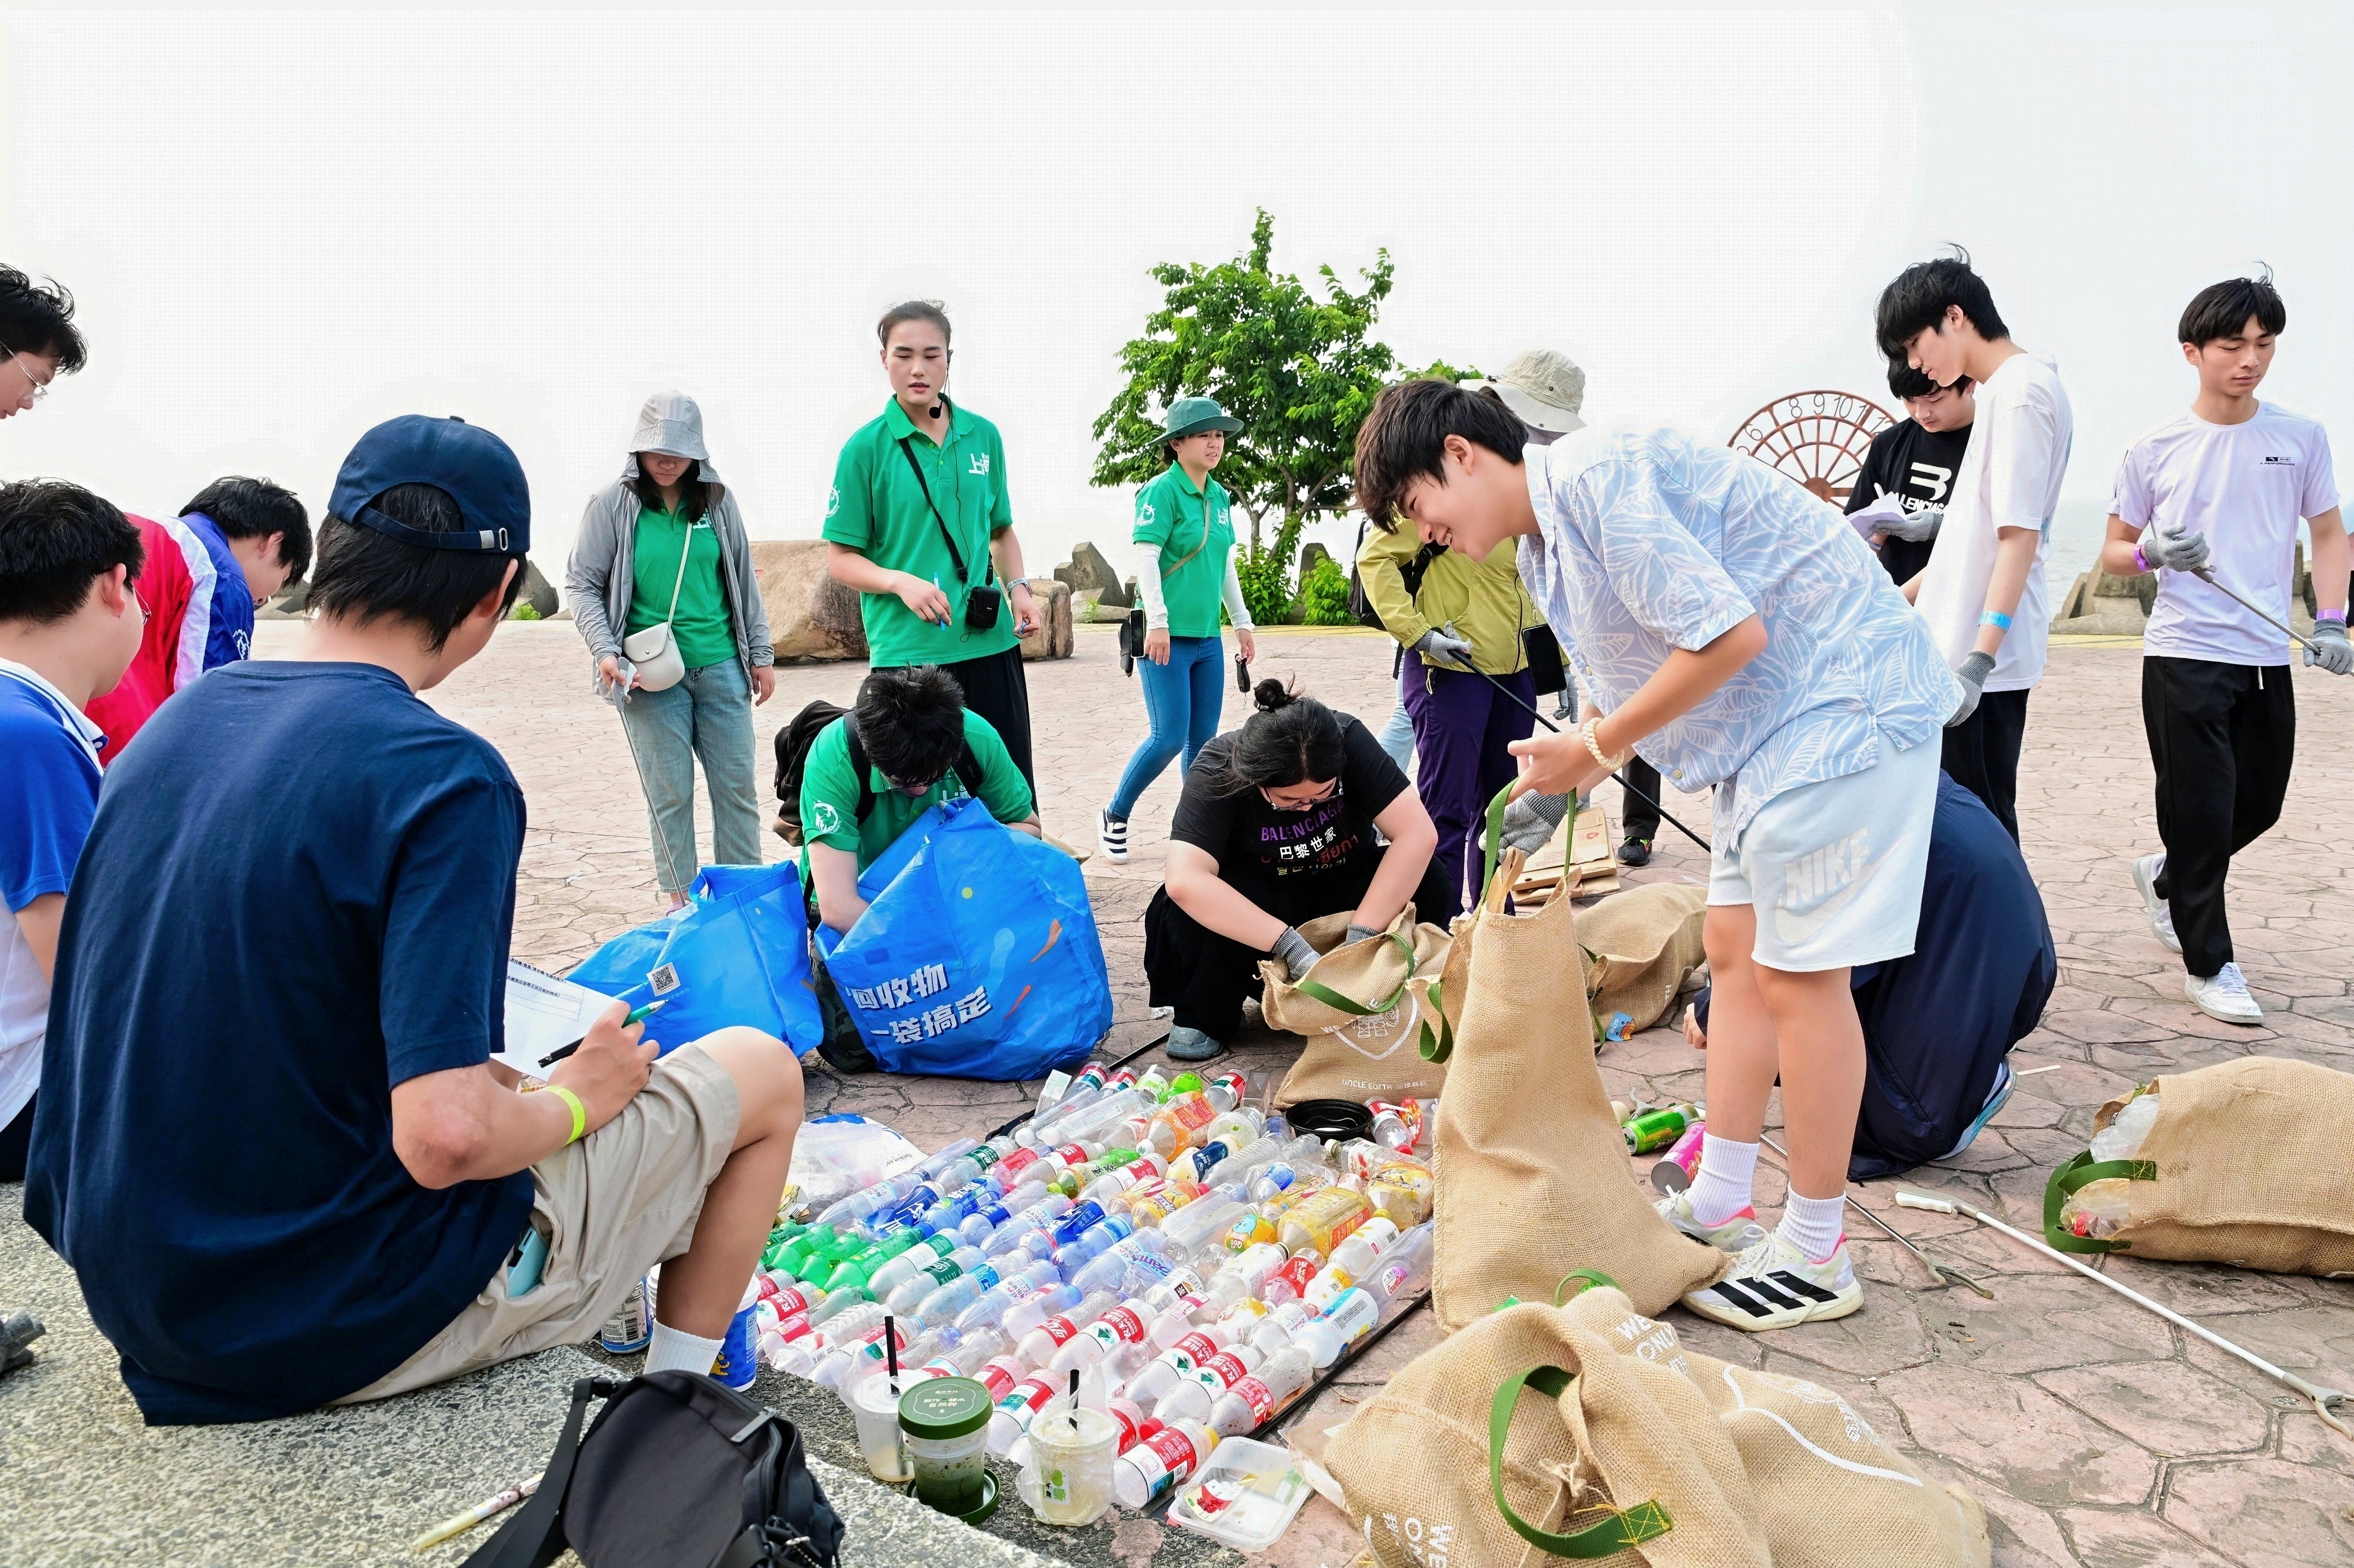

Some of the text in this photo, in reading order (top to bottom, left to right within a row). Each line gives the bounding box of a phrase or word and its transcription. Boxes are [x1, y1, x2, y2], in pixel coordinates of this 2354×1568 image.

[1788, 397, 1803, 419] 8
[1813, 393, 1826, 415] 9
[1833, 395, 1854, 419] 10
[1894, 492, 1948, 516] LENCIAG
[1261, 799, 1345, 841] BALENCIAGA
[1279, 826, 1336, 860] 巴黎世家
[1784, 826, 1869, 907] NIKE
[846, 963, 948, 1010] 回收物
[870, 985, 992, 1045] 一袋搞定
[1610, 1018, 1619, 1033] IELTS
[893, 1153, 912, 1162] luckin
[1007, 1287, 1018, 1297] ALPS
[1123, 1317, 1135, 1335] NONGFU
[1616, 1314, 1652, 1340] WE
[1636, 1324, 1676, 1361] ONLY
[1225, 1361, 1240, 1378] NONGFU
